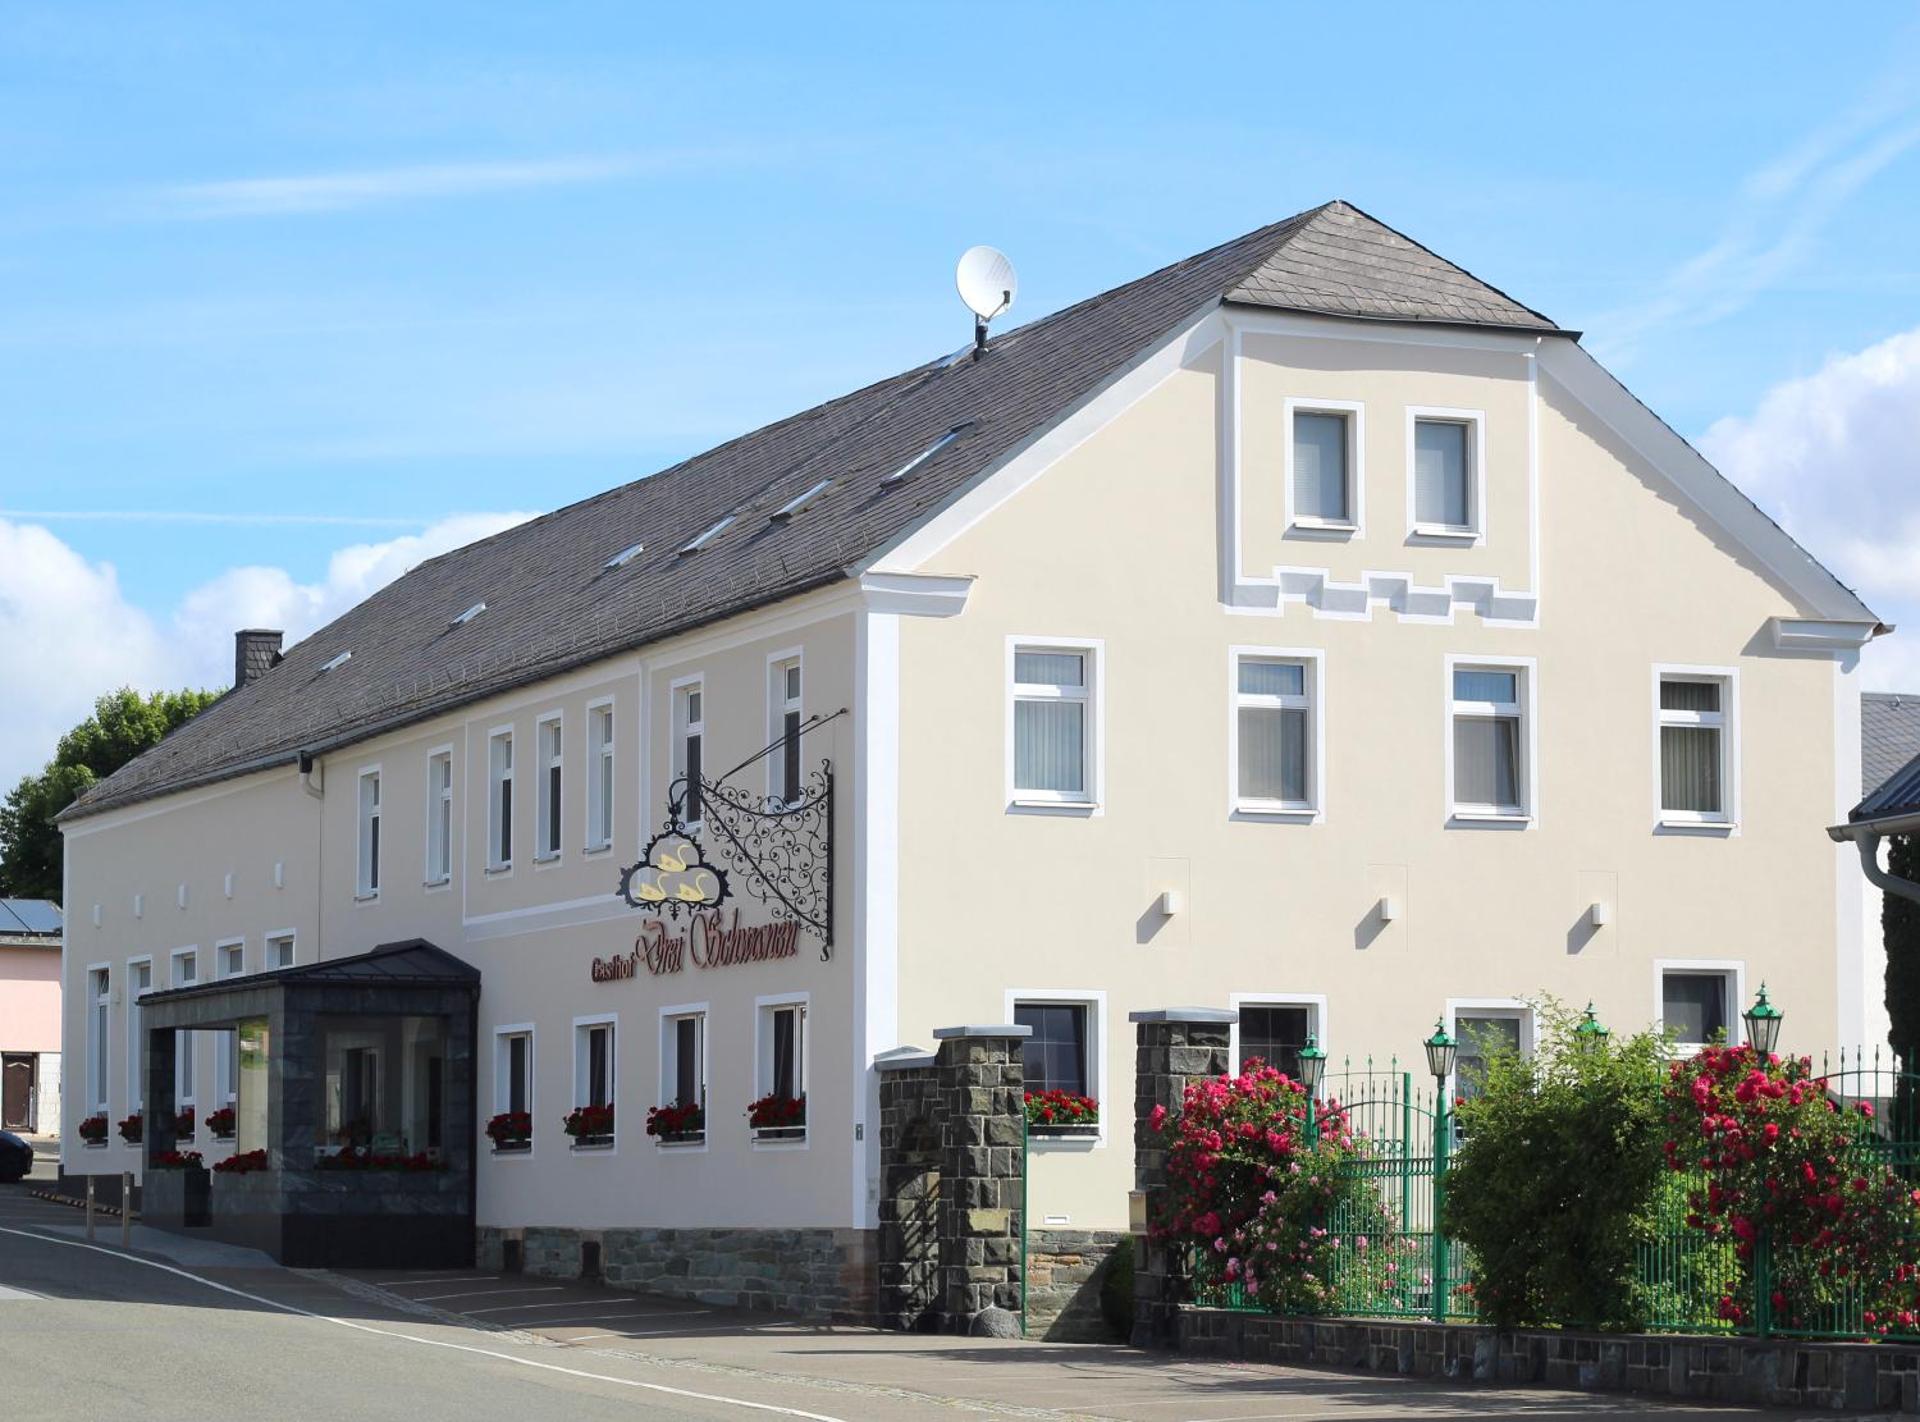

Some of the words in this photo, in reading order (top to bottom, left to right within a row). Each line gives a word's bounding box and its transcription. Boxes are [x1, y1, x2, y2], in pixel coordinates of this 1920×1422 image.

[592, 951, 636, 982] Gasthof
[636, 919, 686, 975] Drei
[690, 907, 800, 969] Schwanen
